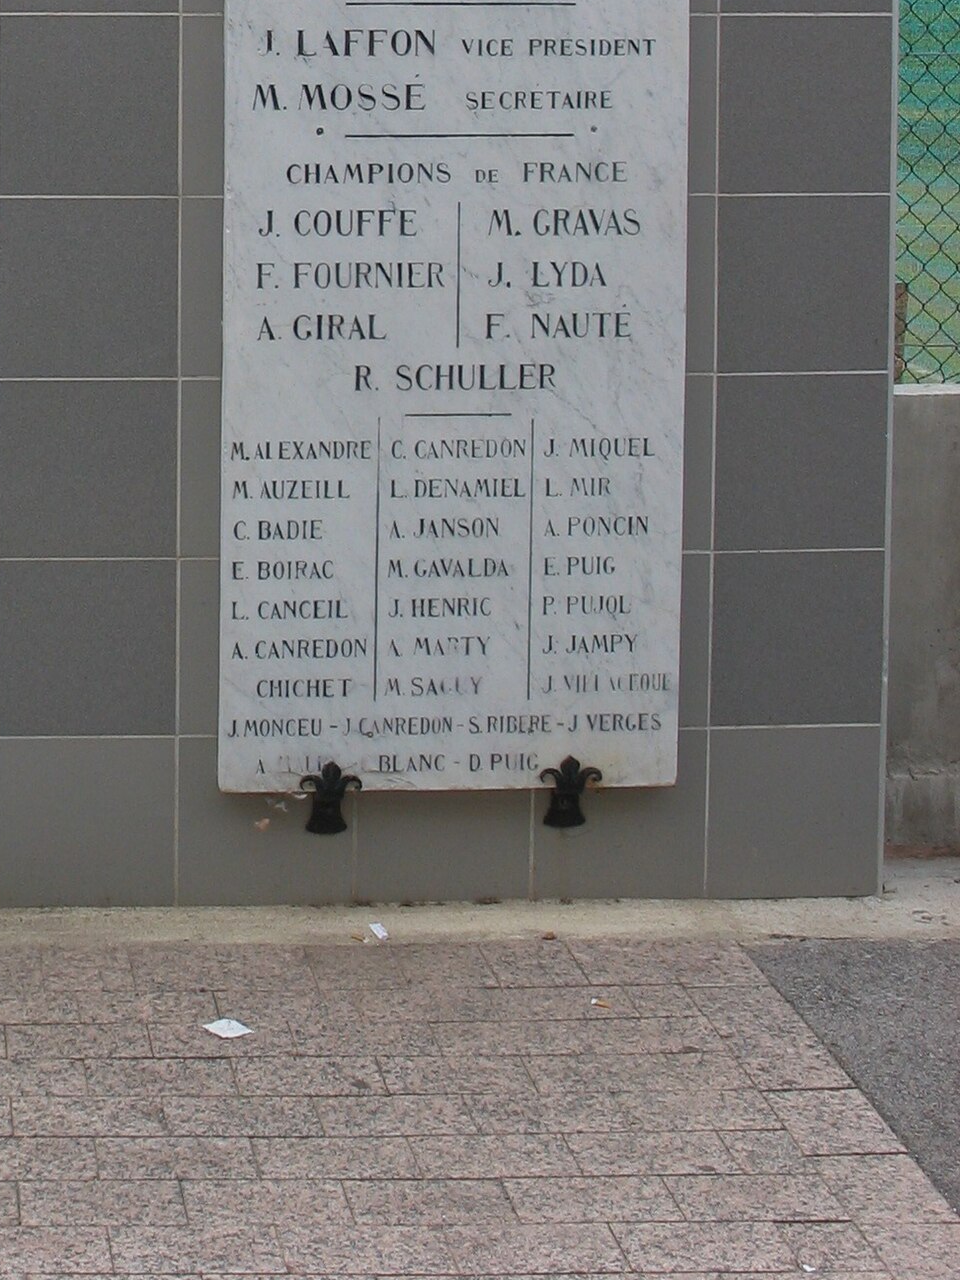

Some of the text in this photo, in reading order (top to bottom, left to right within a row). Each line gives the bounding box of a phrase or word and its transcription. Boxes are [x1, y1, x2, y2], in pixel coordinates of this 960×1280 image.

[297, 29, 436, 57] LAFFON
[461, 38, 513, 56] VICE
[298, 74, 426, 111] MOSSÉ
[286, 163, 452, 184] CHAMPIONS
[523, 162, 627, 183] FRANCE
[294, 210, 417, 237] COUFFE
[533, 209, 641, 236] GRAVAS
[293, 262, 445, 289] FOURNIER
[531, 262, 607, 288] LYDA
[292, 314, 387, 341] GIRAL
[531, 304, 632, 339] NAUTÉ
[396, 364, 556, 391] SCHULLER
[414, 439, 526, 459] CANREDON
[569, 438, 655, 460] MIQUEL
[260, 480, 350, 499] AUZEILL
[414, 479, 526, 498] DENAMIEL
[570, 478, 611, 497] MIR
[258, 521, 323, 540] BADIE
[413, 518, 500, 538] JANSON
[568, 516, 649, 536] PONCIN
[258, 560, 334, 579] BOIRAC
[414, 559, 509, 578] GAVALDA
[567, 556, 615, 575] PUIG
[258, 600, 348, 619] CANCEIL
[412, 597, 492, 617] HENRIC
[567, 595, 632, 615] PUJOL
[255, 638, 367, 659] CANREDON
[566, 634, 638, 654] JAMPY
[257, 679, 352, 698] CHICHET
[379, 755, 446, 773] BLANC
